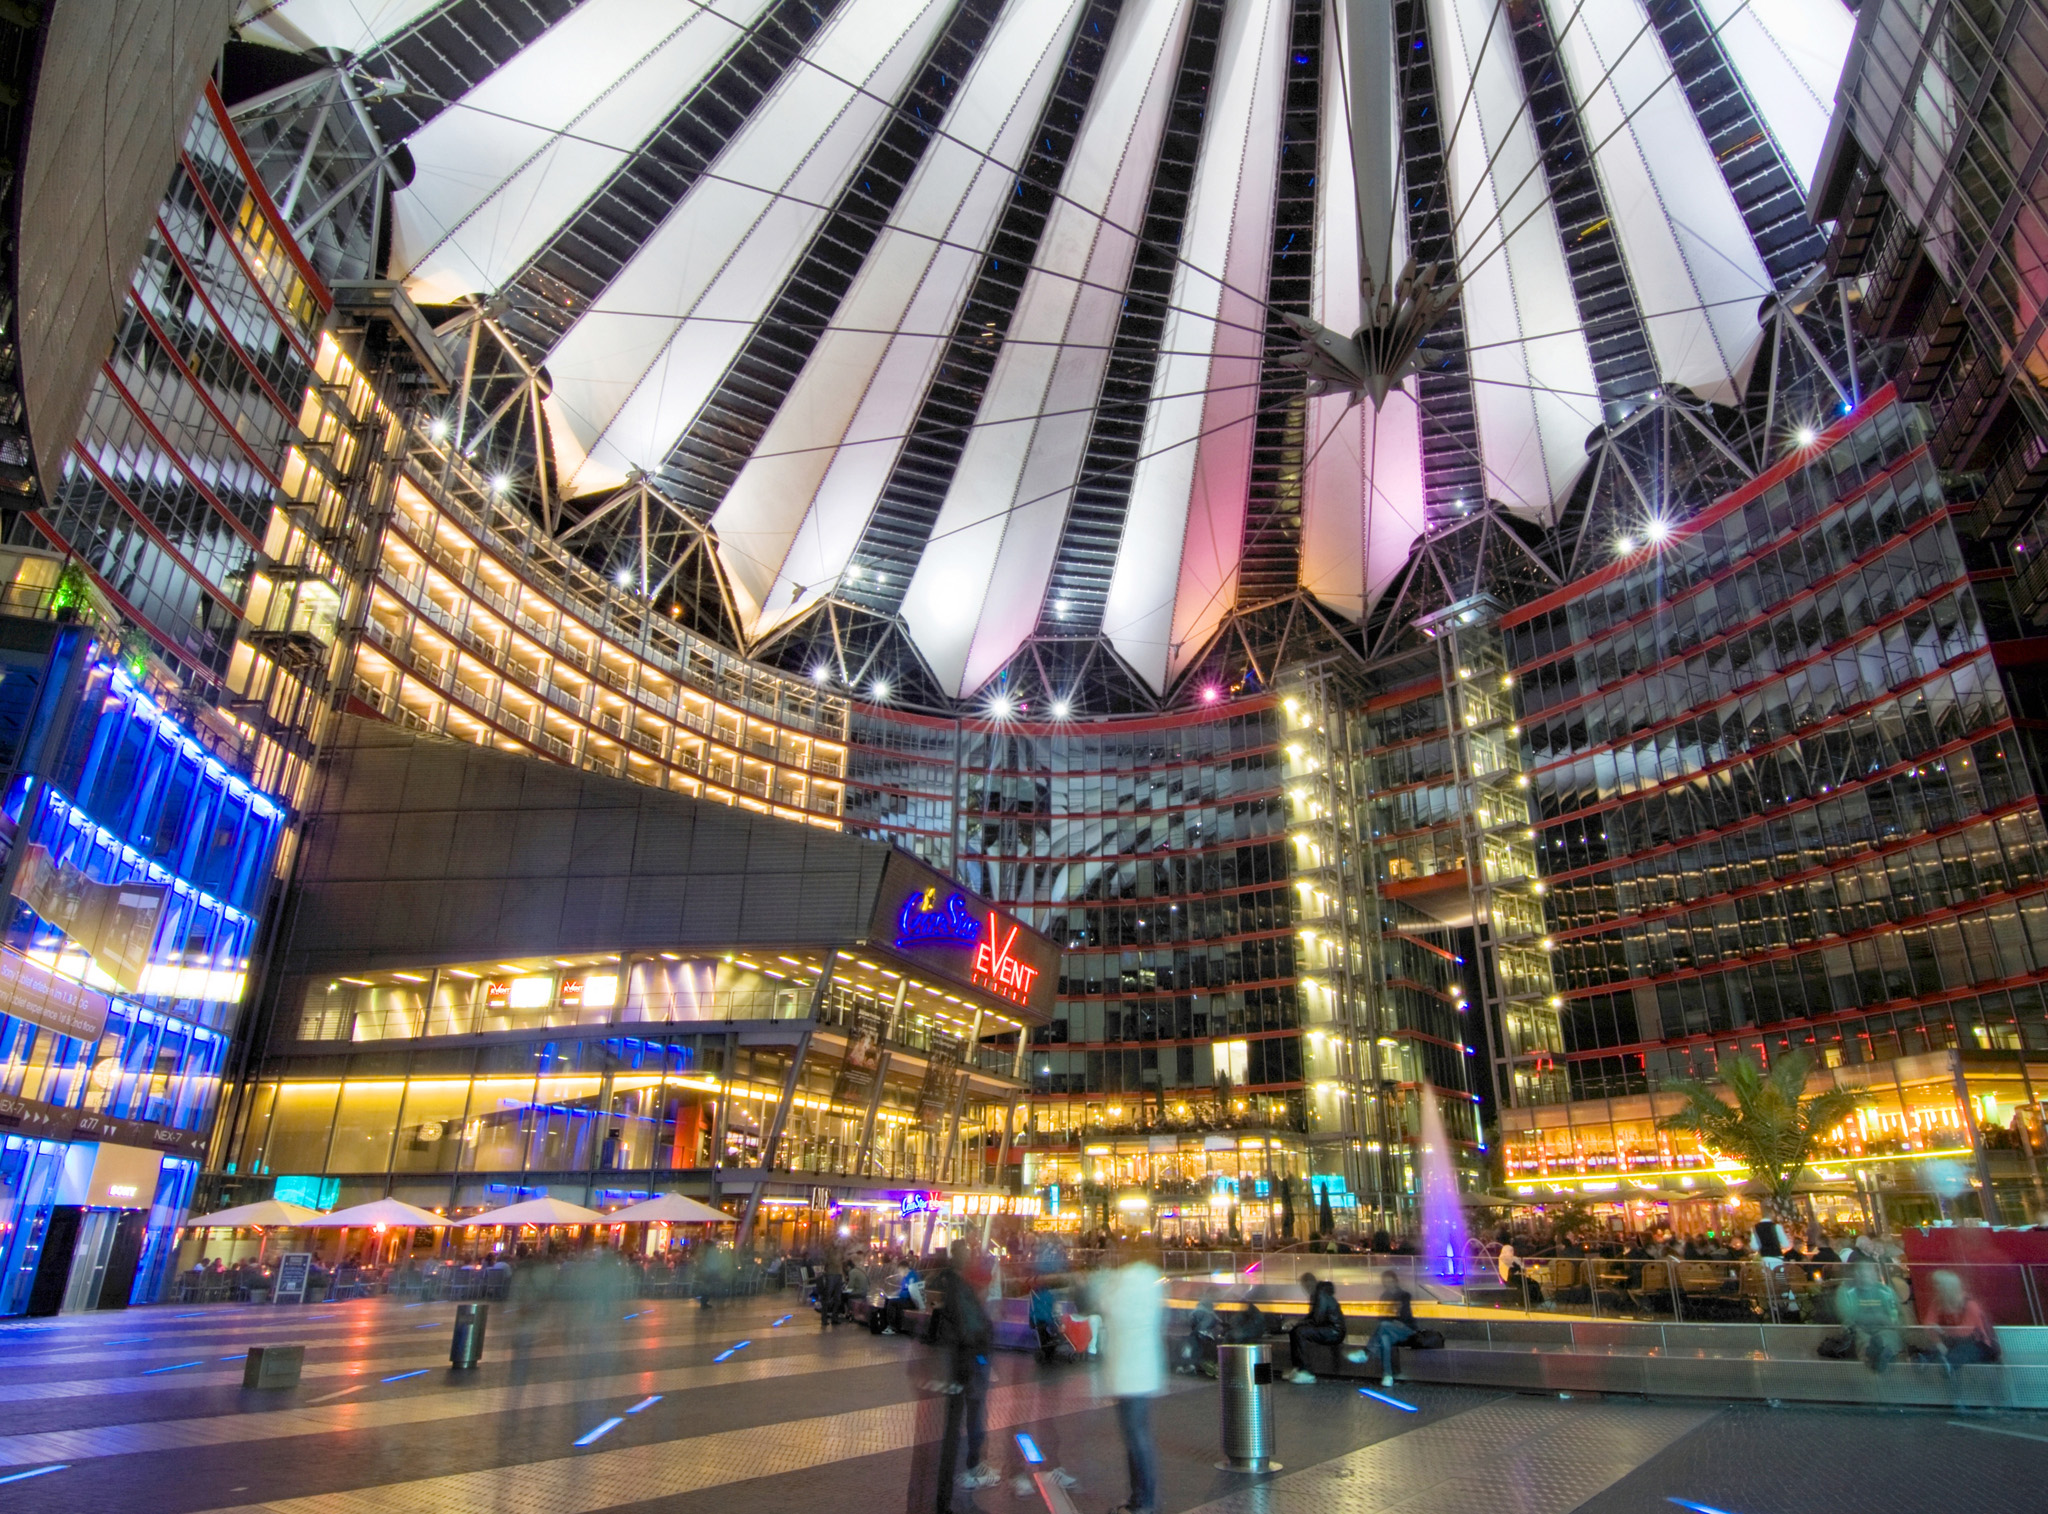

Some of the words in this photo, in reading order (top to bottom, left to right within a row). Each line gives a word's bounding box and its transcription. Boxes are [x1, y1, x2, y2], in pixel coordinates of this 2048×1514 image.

[975, 910, 1037, 993] EVENT
[32, 980, 54, 997] erlebn
[26, 1001, 58, 1021] experence
[0, 1098, 25, 1115] EX-7
[154, 1128, 183, 1143] NEX-7
